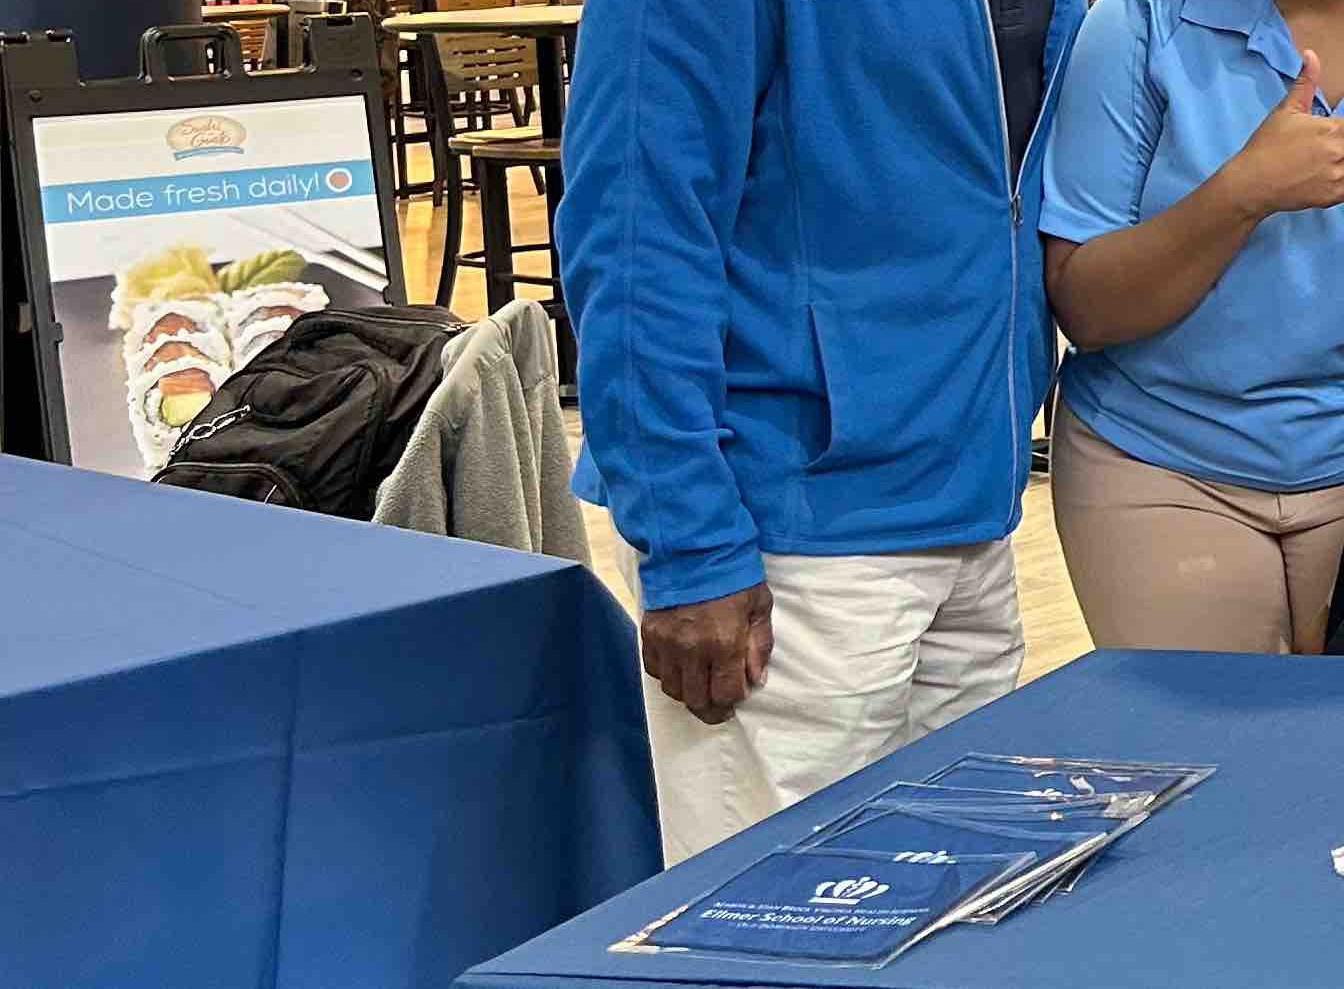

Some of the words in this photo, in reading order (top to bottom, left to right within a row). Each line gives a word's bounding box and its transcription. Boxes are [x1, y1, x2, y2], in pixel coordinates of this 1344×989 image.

[67, 189, 154, 213] Made
[161, 182, 240, 205] fresh
[249, 171, 320, 201] daily!
[700, 909, 760, 922] Ellmer
[760, 912, 824, 924] School
[823, 915, 847, 925] of
[845, 915, 918, 926] Nursing
